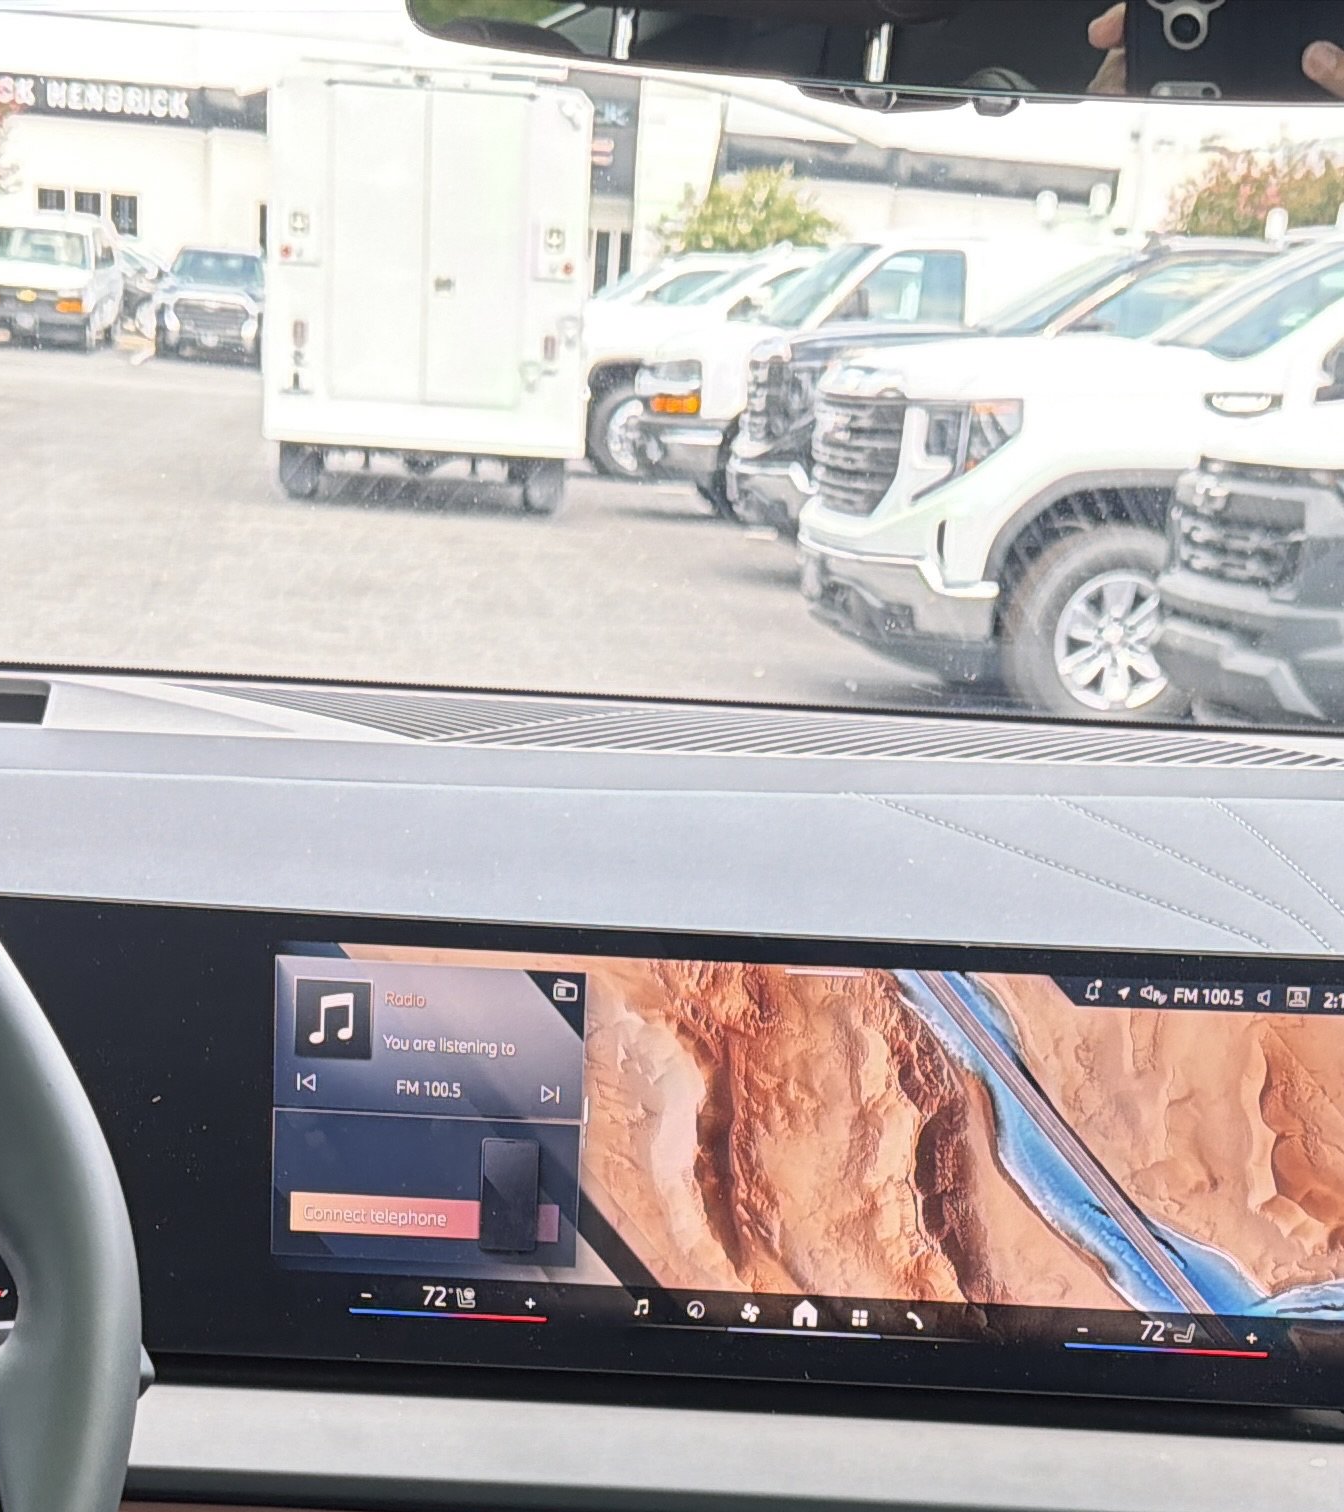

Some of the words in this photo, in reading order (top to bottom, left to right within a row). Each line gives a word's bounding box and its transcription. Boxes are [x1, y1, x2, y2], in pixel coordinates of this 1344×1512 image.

[46, 79, 190, 119] HENDRICK
[384, 990, 426, 1008] Radio
[1173, 987, 1198, 1005] FM
[1202, 988, 1244, 1006] 100.5
[382, 1033, 410, 1051] You
[413, 1039, 436, 1052] are
[439, 1036, 498, 1058] listening
[501, 1041, 516, 1056] to
[396, 1079, 420, 1096] FM
[423, 1081, 462, 1098] 100.5
[303, 1204, 366, 1223] Connect
[370, 1207, 447, 1228] telephone
